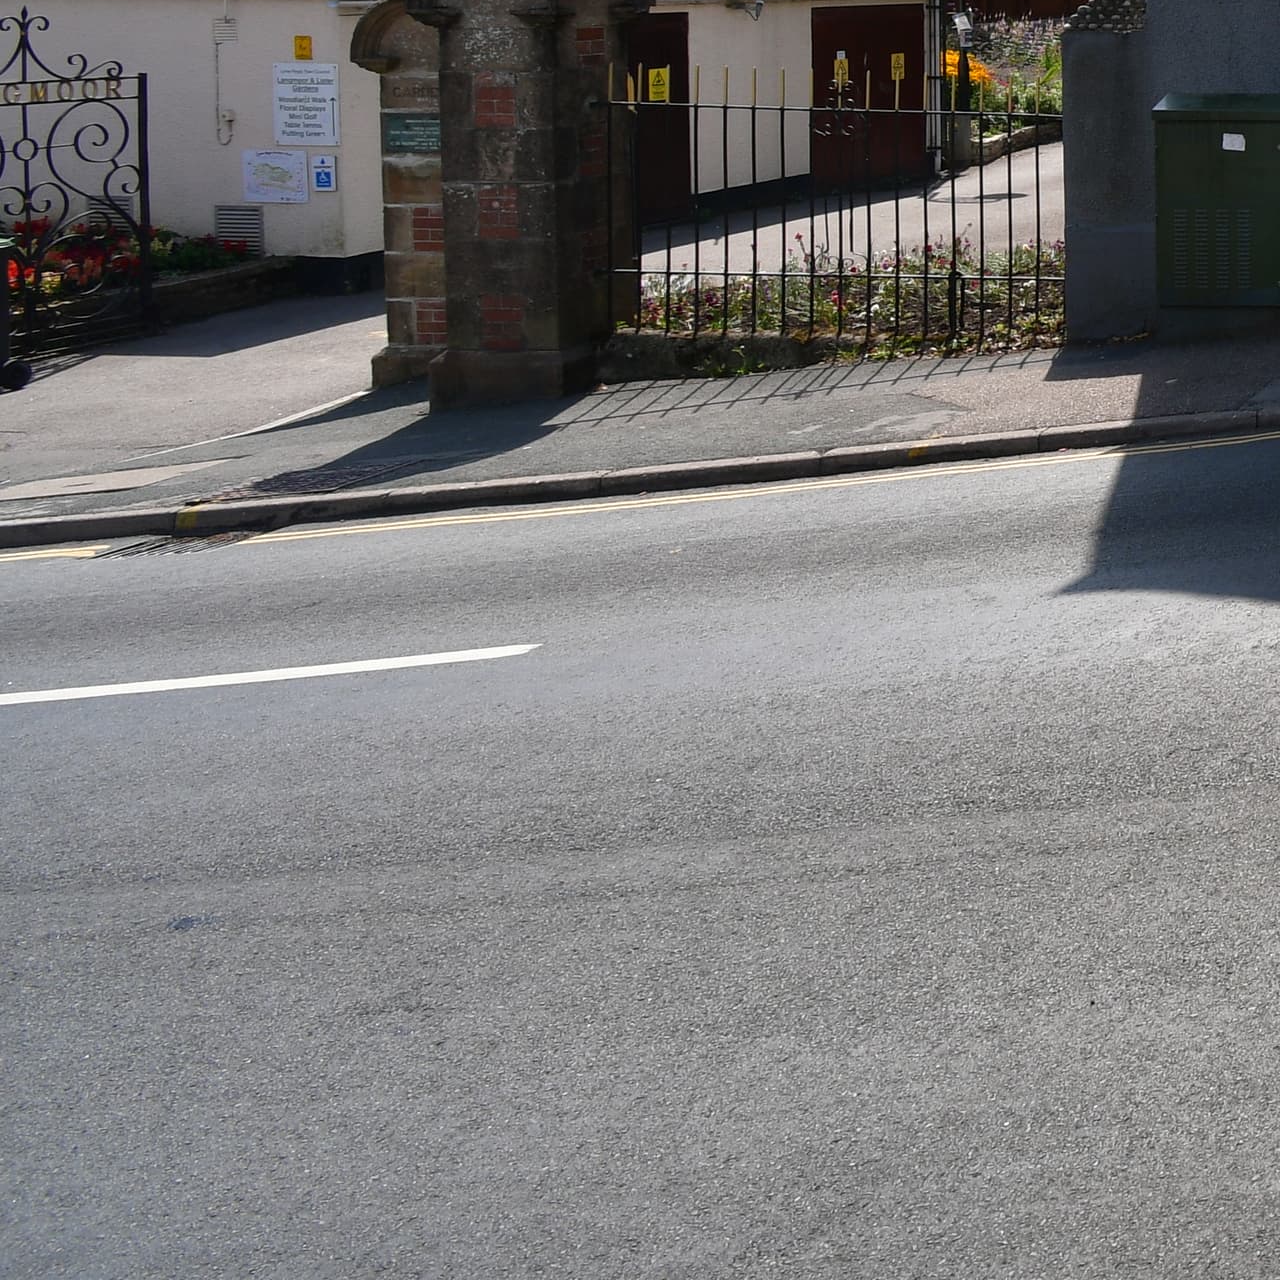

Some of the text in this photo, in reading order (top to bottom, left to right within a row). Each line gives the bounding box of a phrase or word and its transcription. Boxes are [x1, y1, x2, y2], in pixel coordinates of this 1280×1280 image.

[280, 104, 326, 112] Floral Displays
[281, 130, 304, 138] Putting
